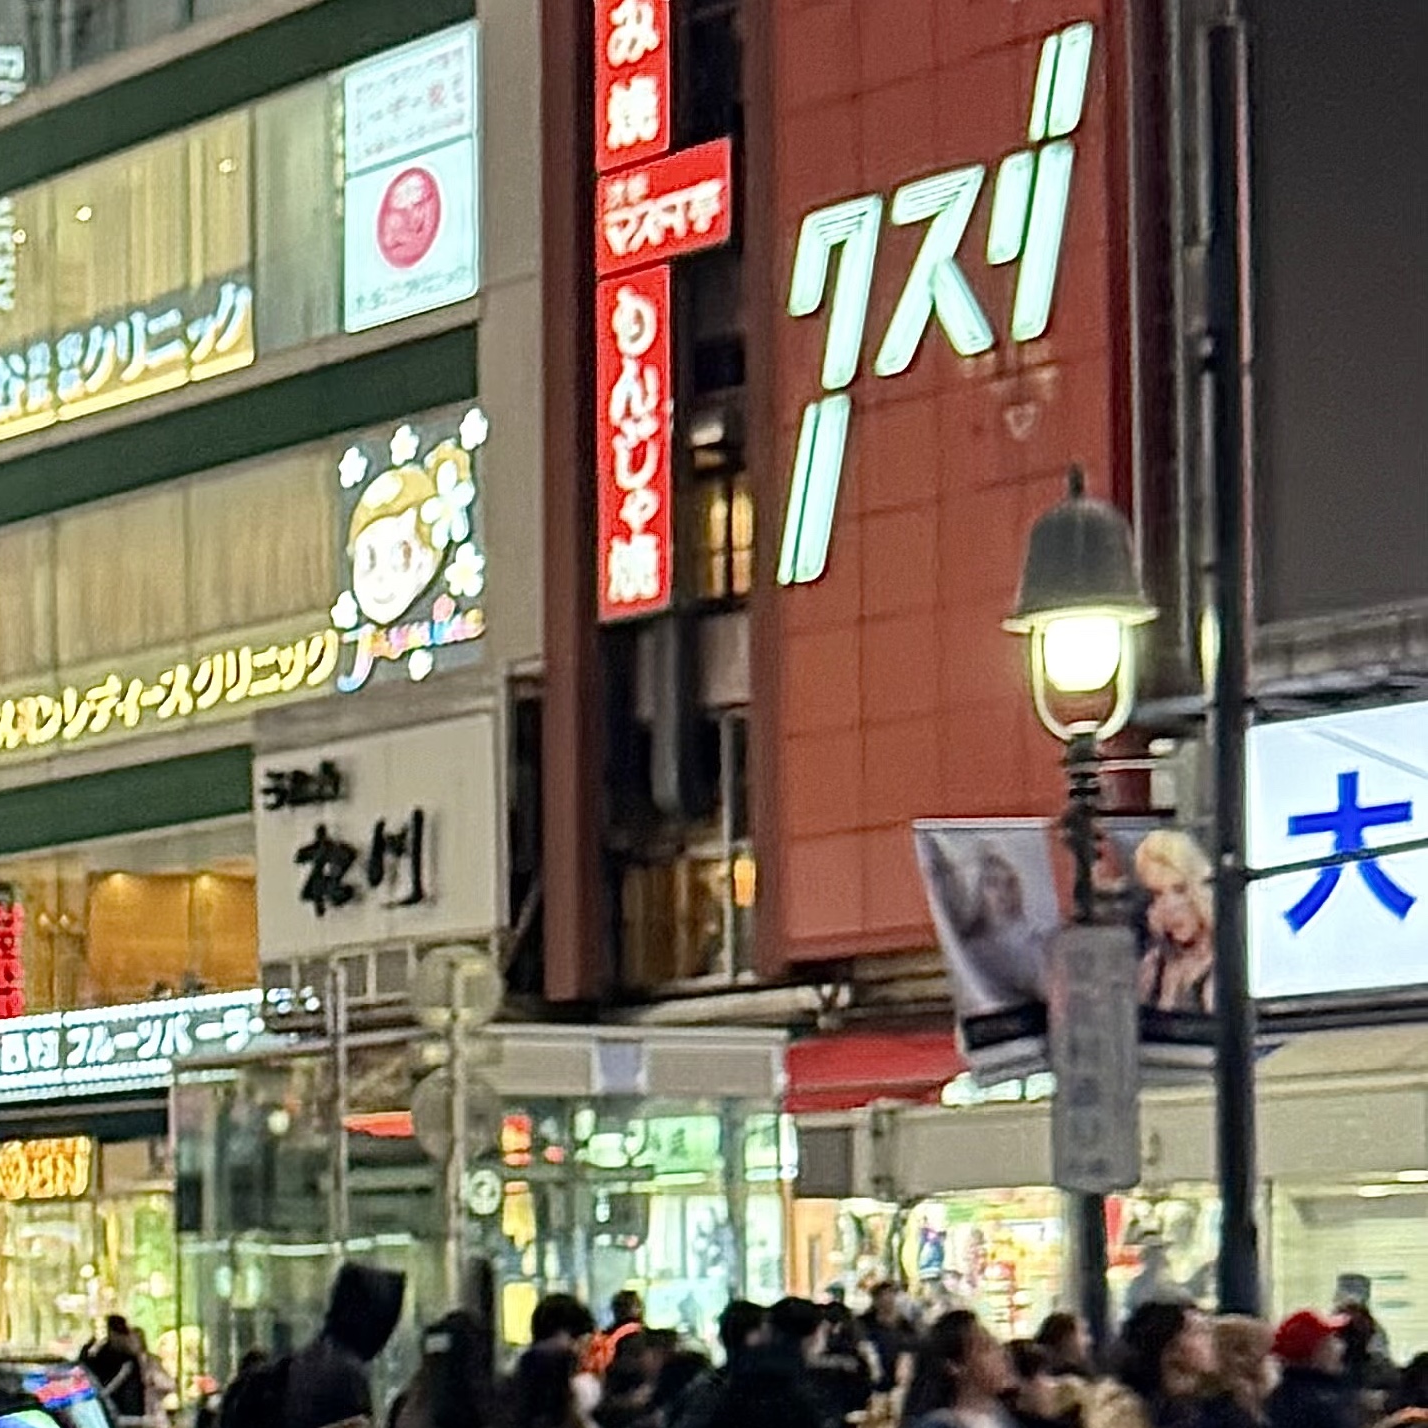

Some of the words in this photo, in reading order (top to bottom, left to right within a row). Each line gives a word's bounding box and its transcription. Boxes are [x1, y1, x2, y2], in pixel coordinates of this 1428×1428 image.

[777, 20, 1094, 588] クスリ
[1282, 770, 1416, 935] 大
